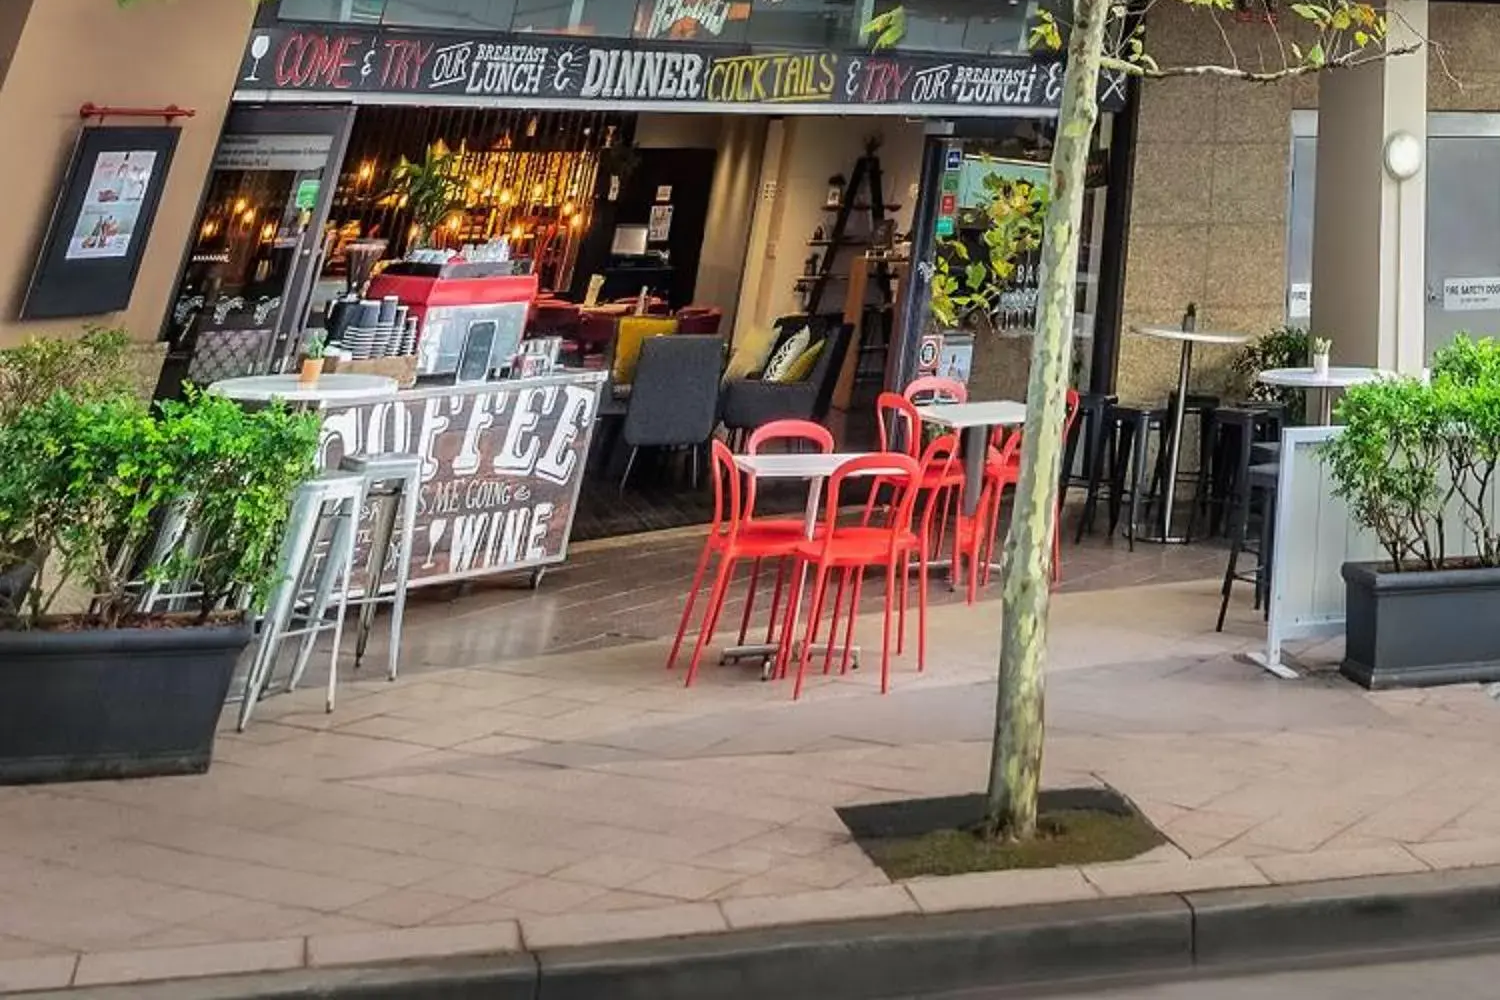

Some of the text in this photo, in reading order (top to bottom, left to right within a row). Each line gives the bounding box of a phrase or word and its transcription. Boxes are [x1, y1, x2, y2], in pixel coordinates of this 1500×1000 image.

[275, 31, 362, 89] COME
[381, 38, 434, 89] TRY
[432, 46, 471, 82] OUR
[475, 43, 549, 63] BREAKFAST
[465, 60, 546, 94] LUNCH
[554, 51, 574, 91] &
[580, 48, 703, 98] DINNER
[845, 58, 861, 101] &
[863, 58, 913, 102] TRY
[911, 69, 950, 103] OUR
[954, 65, 1030, 85] BREAKFAST
[957, 74, 1035, 103] LUNCH
[1446, 285, 1459, 295] FIRE
[1461, 285, 1485, 295] SAFETY
[429, 480, 463, 515] ME
[465, 479, 512, 508] GOING
[449, 502, 553, 573] WINE
